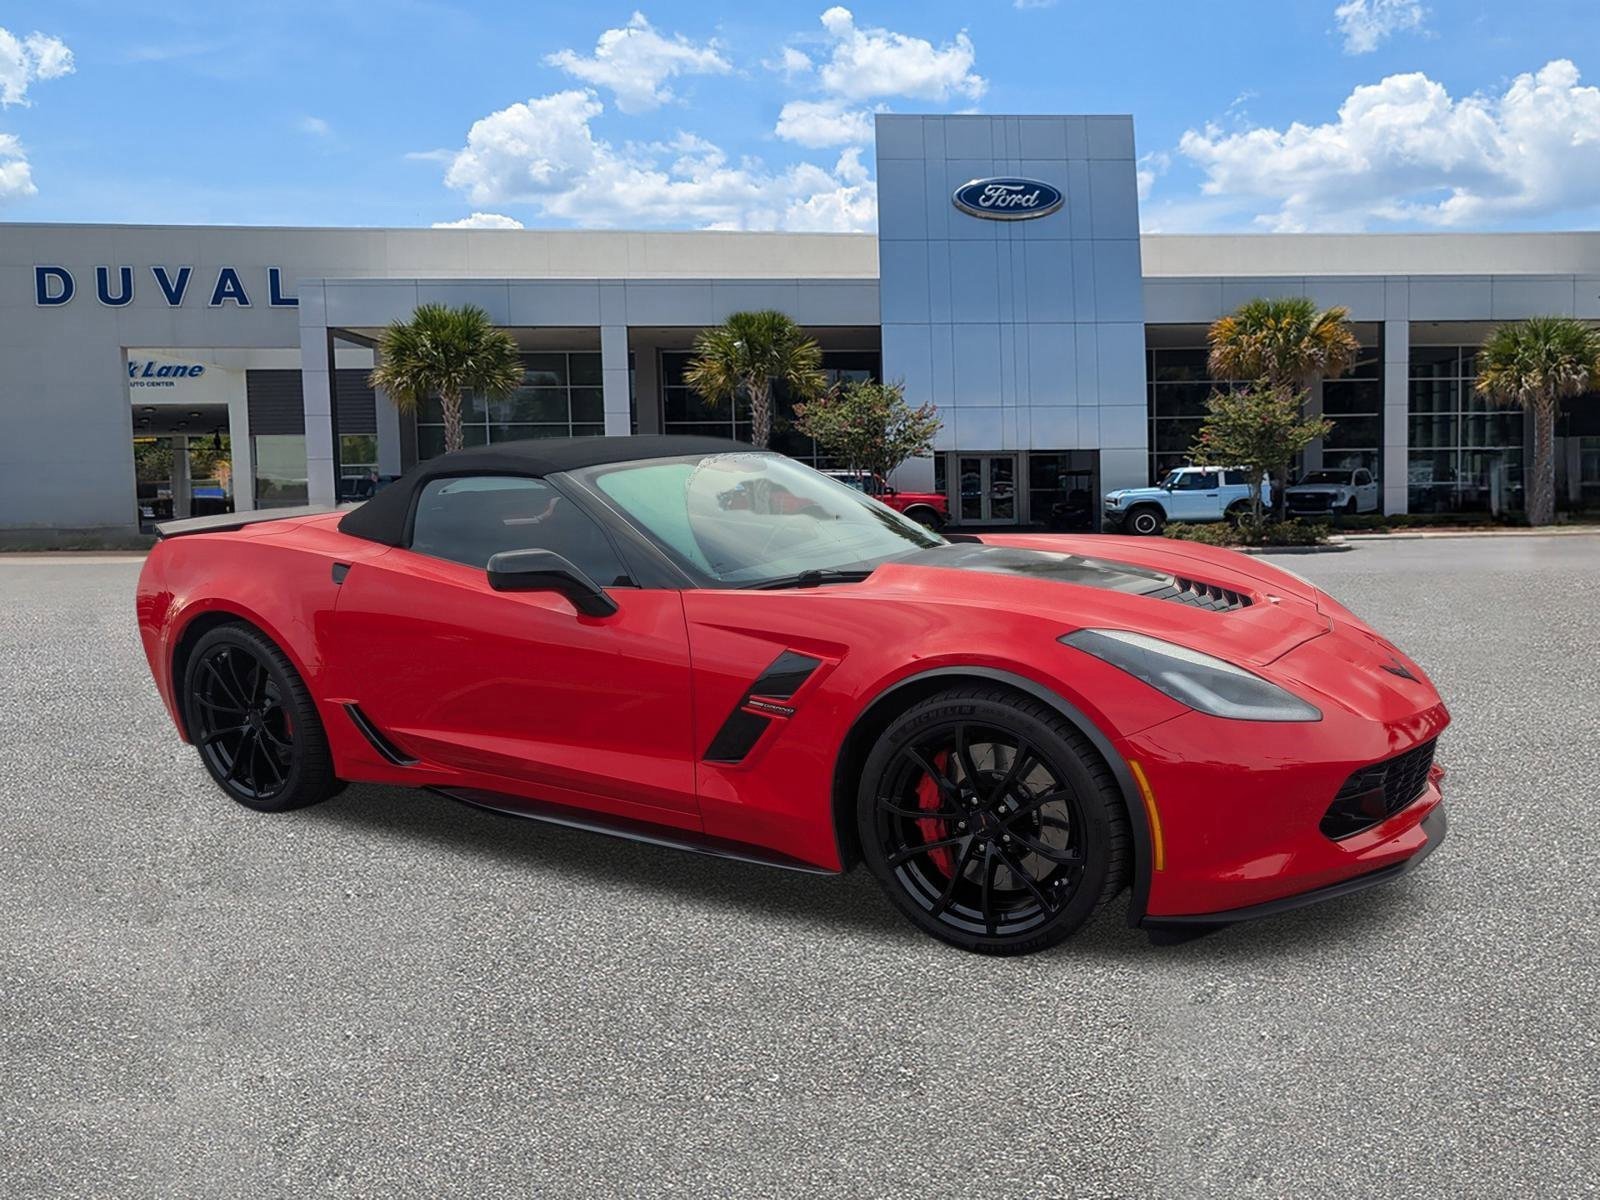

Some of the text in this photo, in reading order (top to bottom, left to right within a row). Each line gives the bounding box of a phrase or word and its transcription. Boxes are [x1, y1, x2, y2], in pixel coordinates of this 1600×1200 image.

[979, 184, 1040, 207] Ford
[34, 265, 299, 307] DUVAL
[142, 361, 204, 378] Lane
[146, 380, 175, 388] CENTER
